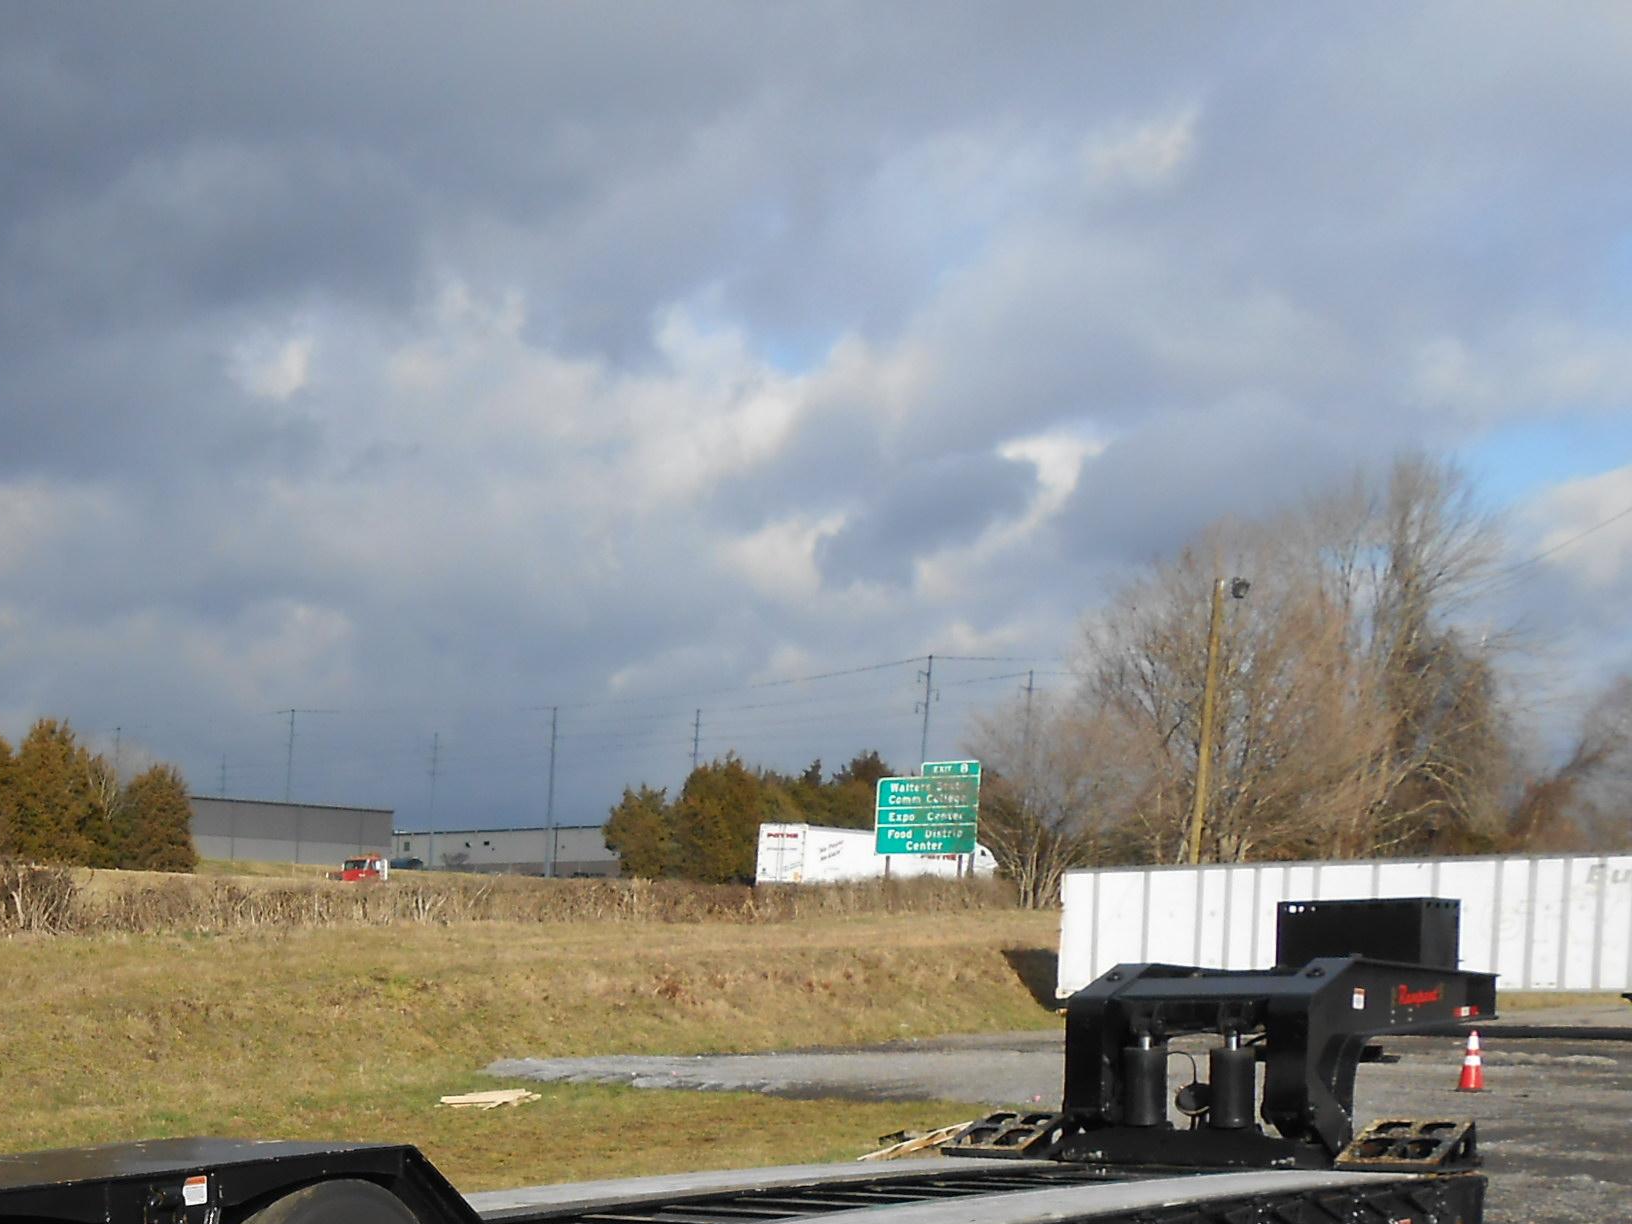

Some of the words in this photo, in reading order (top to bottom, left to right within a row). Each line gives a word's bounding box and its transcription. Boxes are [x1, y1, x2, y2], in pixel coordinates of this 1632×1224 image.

[933, 765, 953, 774] EXIT
[888, 794, 922, 805] Comm
[888, 812, 915, 823] Expo
[887, 829, 913, 839] Food
[905, 840, 943, 851] Center
